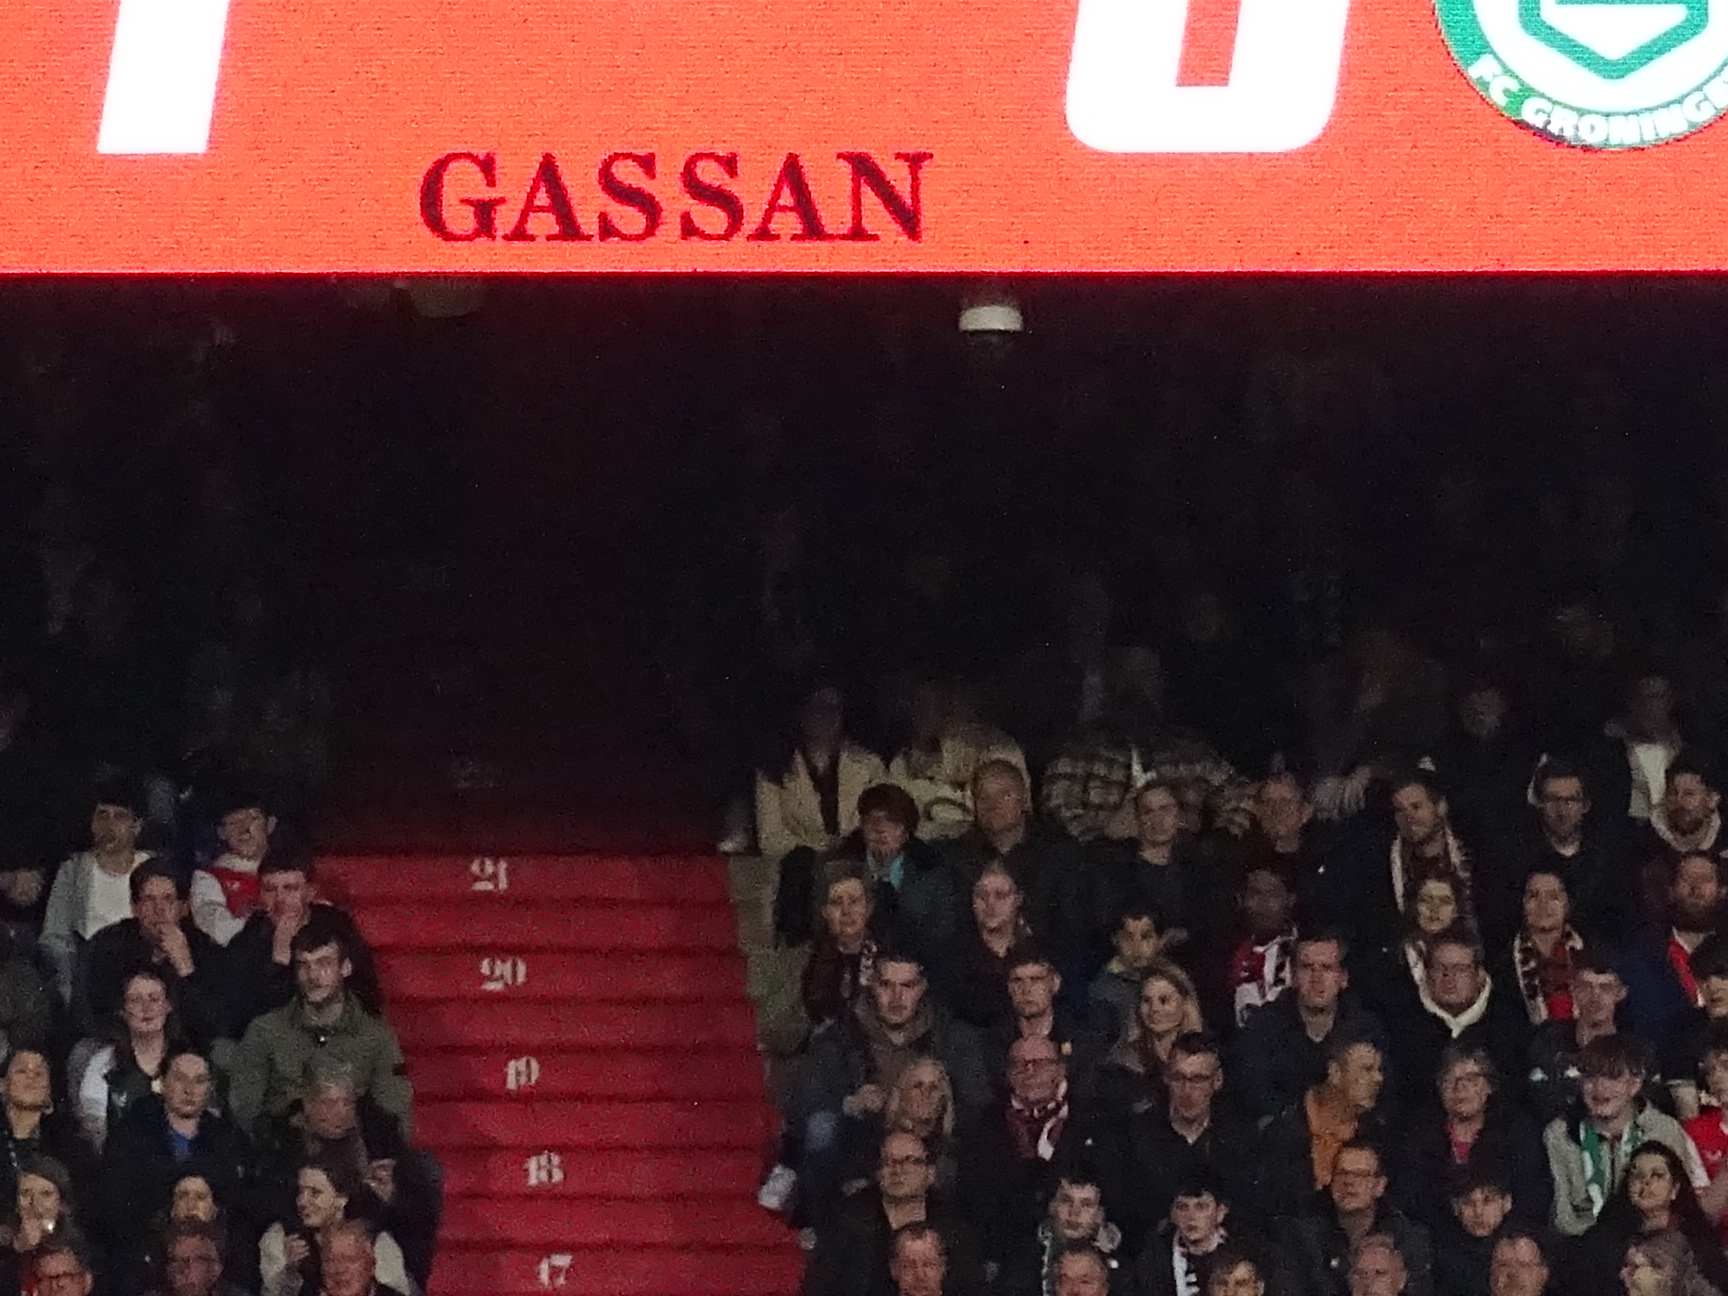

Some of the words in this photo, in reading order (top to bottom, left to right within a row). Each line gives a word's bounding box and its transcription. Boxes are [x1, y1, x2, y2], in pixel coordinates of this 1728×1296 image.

[1467, 53, 1522, 107] FC
[420, 152, 935, 244] GASSAN
[472, 858, 508, 892] 21
[480, 958, 527, 991] 20
[524, 1152, 564, 1187] 18
[538, 1254, 572, 1287] 17
